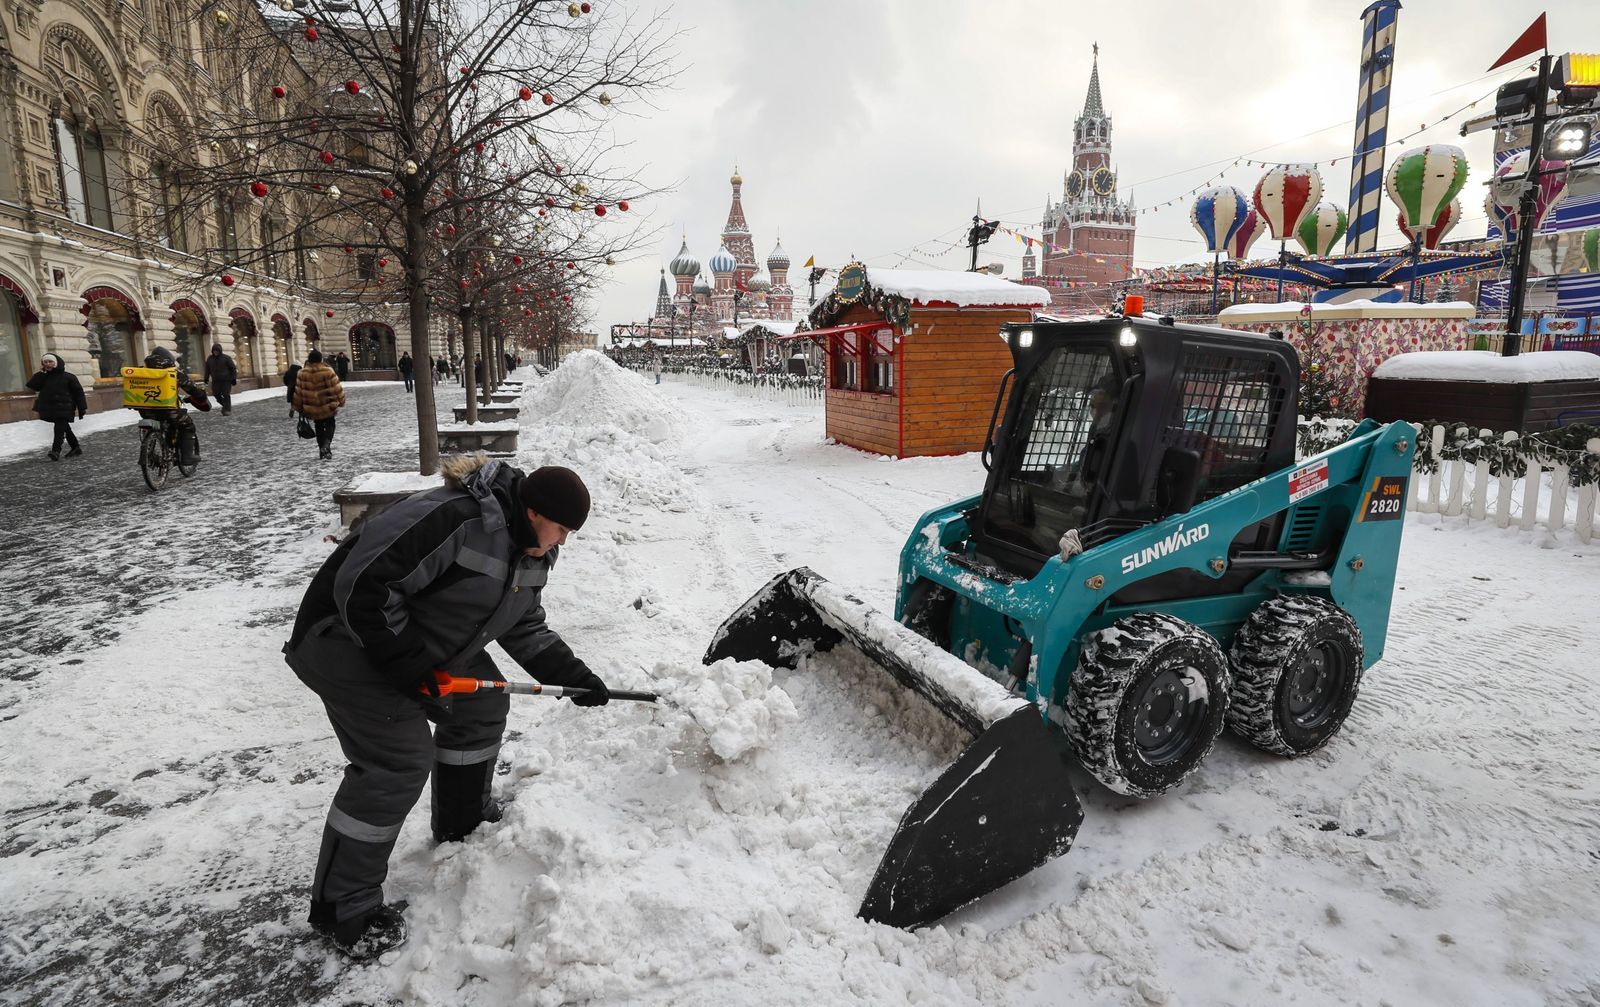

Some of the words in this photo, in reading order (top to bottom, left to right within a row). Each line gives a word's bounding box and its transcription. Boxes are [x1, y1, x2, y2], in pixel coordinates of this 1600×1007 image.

[1383, 484, 1401, 496] SWL
[1370, 499, 1400, 514] 2820
[1121, 523, 1210, 575] SUNWARD
